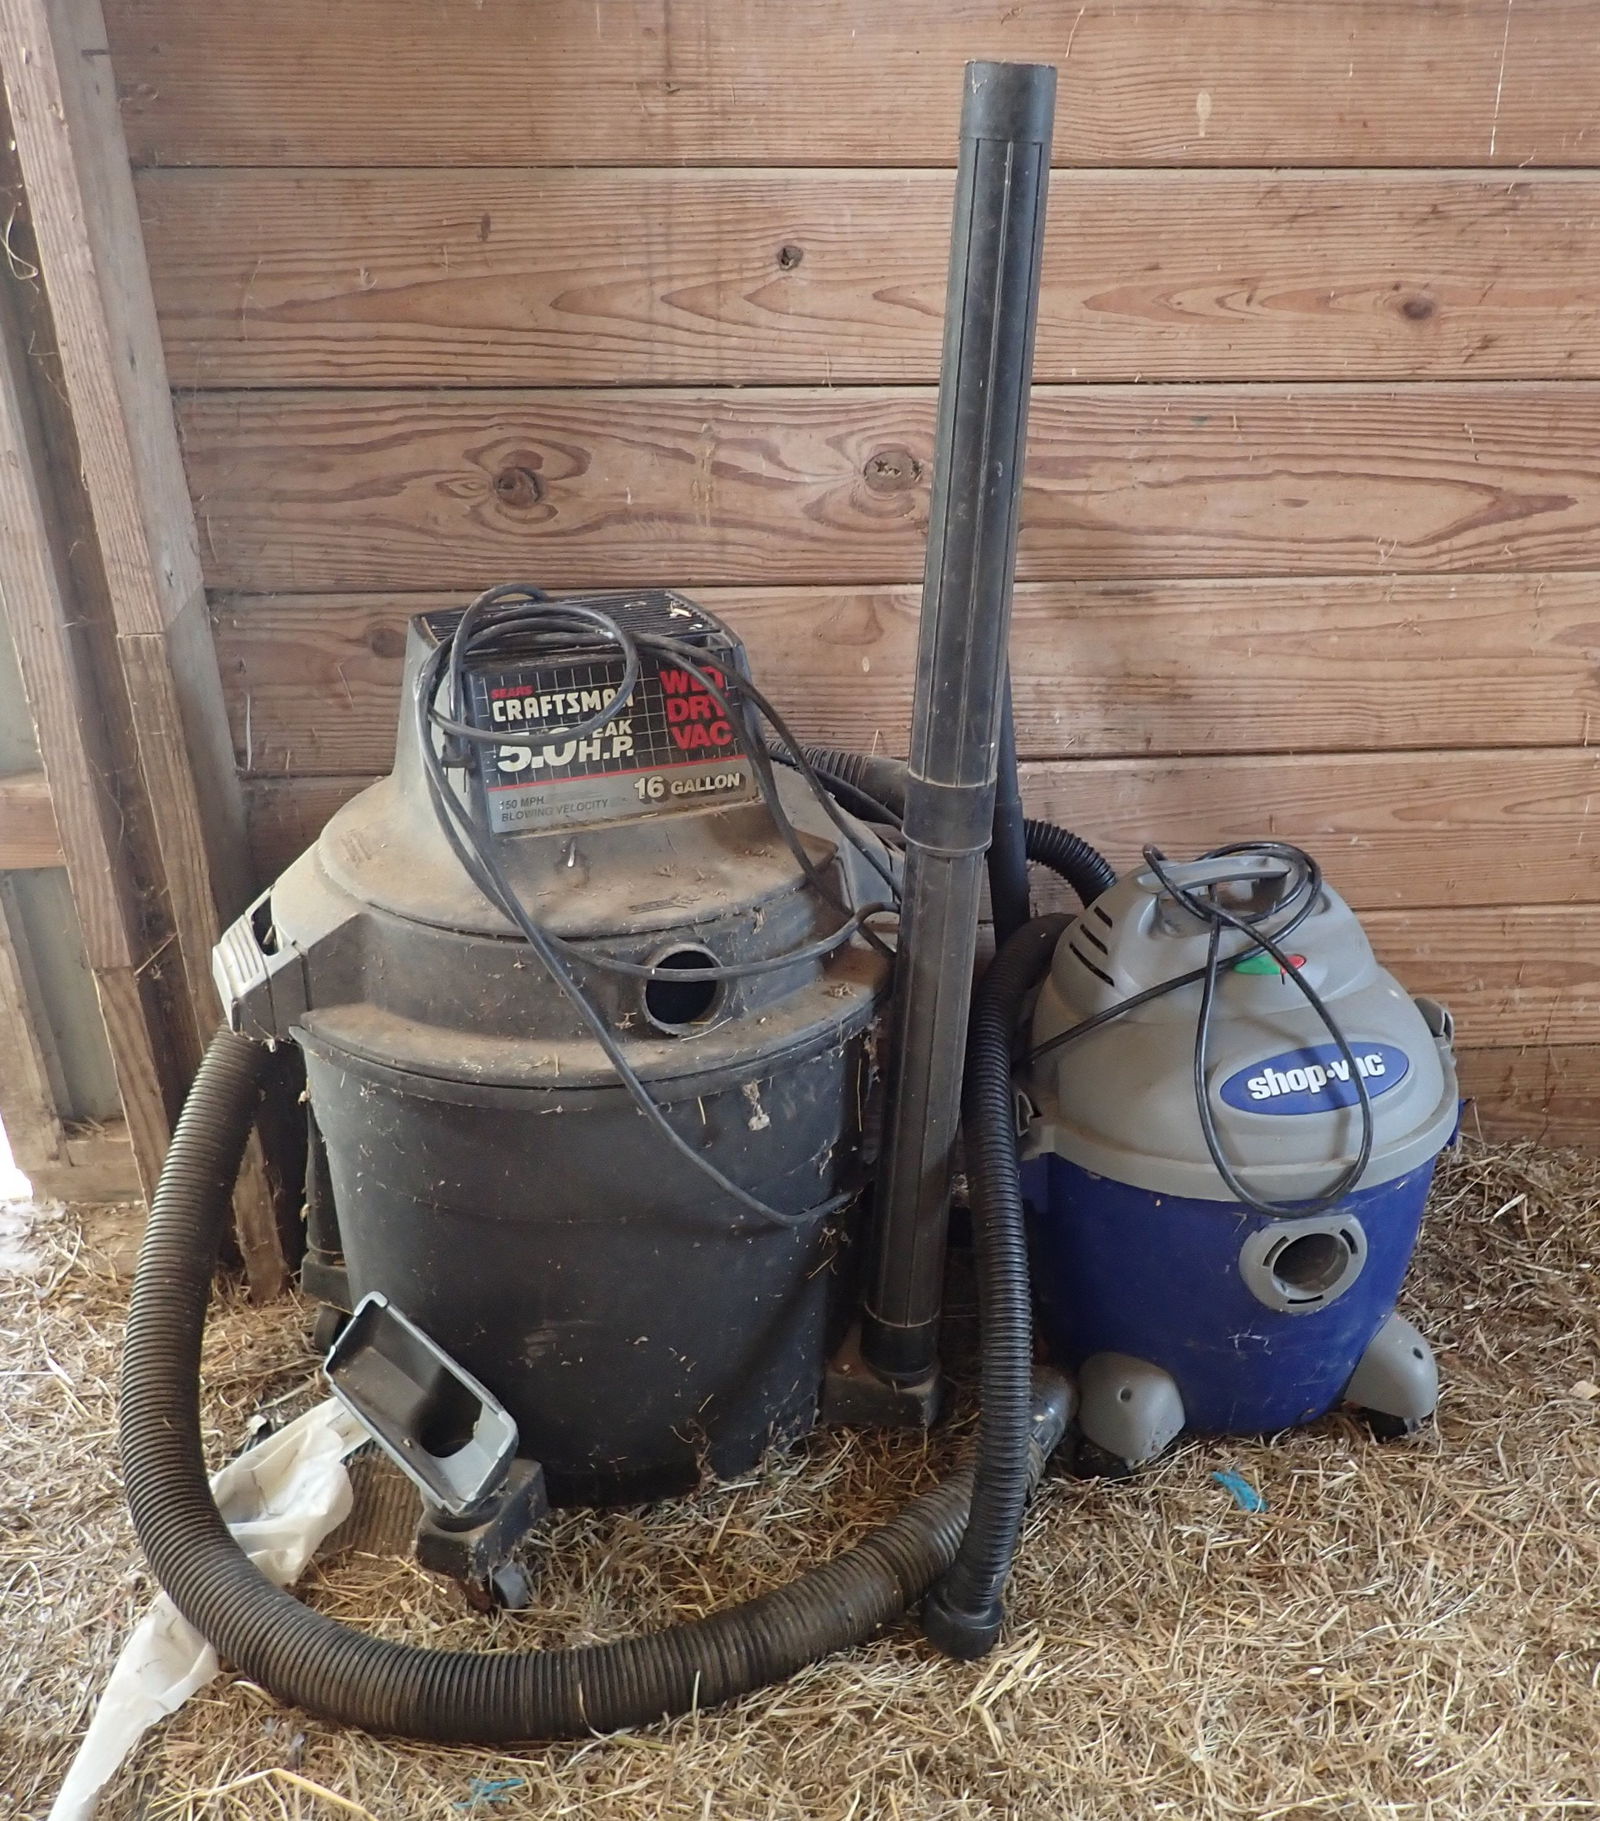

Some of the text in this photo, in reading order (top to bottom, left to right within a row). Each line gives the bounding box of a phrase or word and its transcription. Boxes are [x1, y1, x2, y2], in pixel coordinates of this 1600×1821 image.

[491, 685, 534, 699] SEARS
[580, 719, 633, 741] EAK
[671, 720, 733, 750] VAC
[497, 727, 577, 773] 5.0
[578, 736, 634, 763] H.P.
[634, 772, 740, 800] 16 GALLON
[501, 798, 609, 822] BLOWING VELOCITY
[520, 796, 545, 808] MPH
